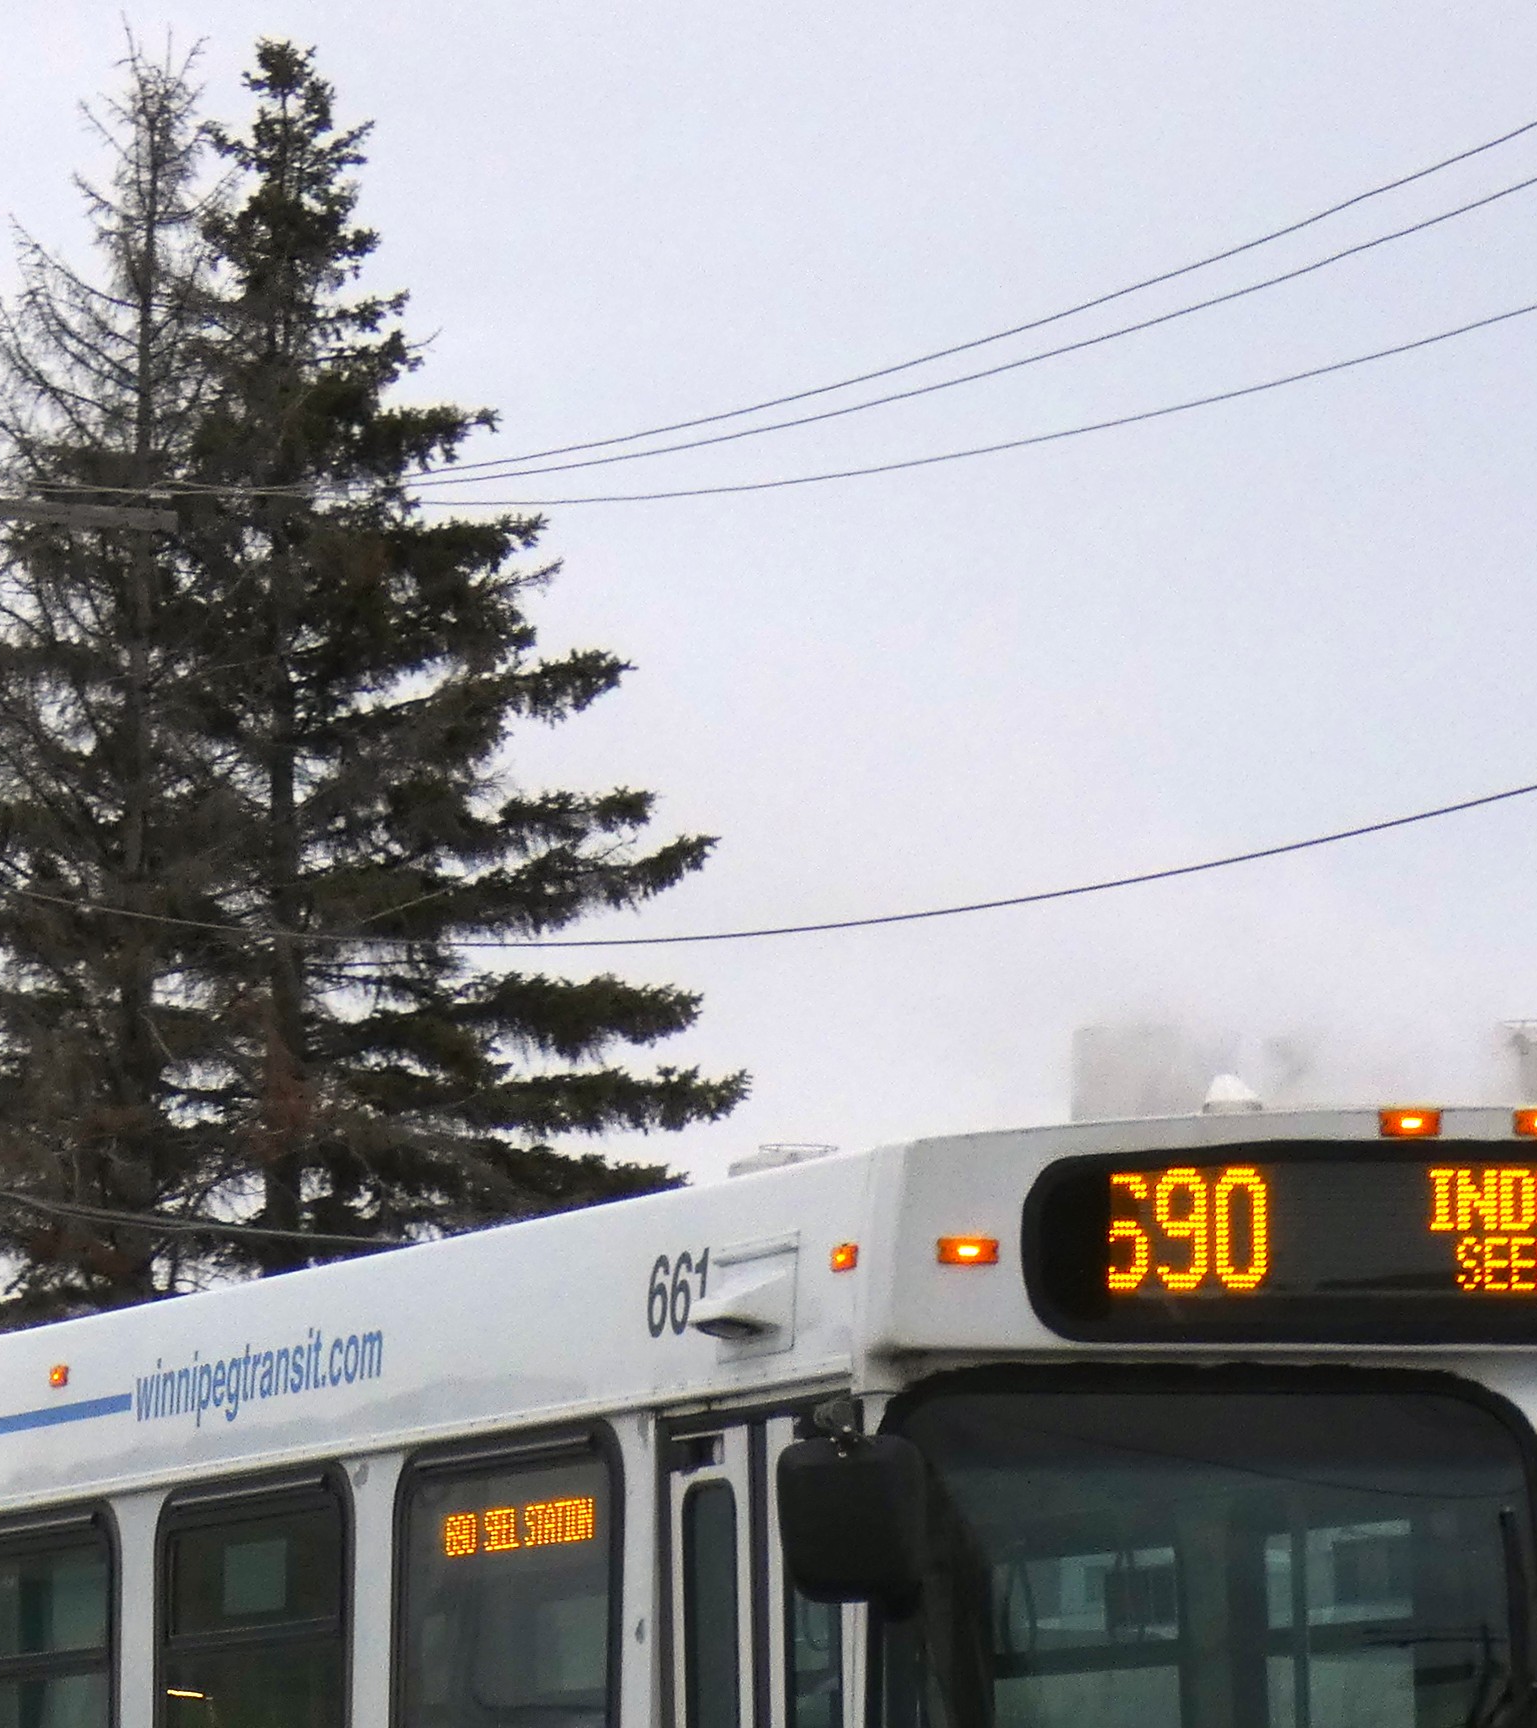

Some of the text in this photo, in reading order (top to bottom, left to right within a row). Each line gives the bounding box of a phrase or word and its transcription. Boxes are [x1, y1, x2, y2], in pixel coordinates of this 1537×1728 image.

[647, 1247, 710, 1338] 661
[136, 1327, 383, 1427] winnipegtransit.com
[524, 1498, 593, 1547] STATION
